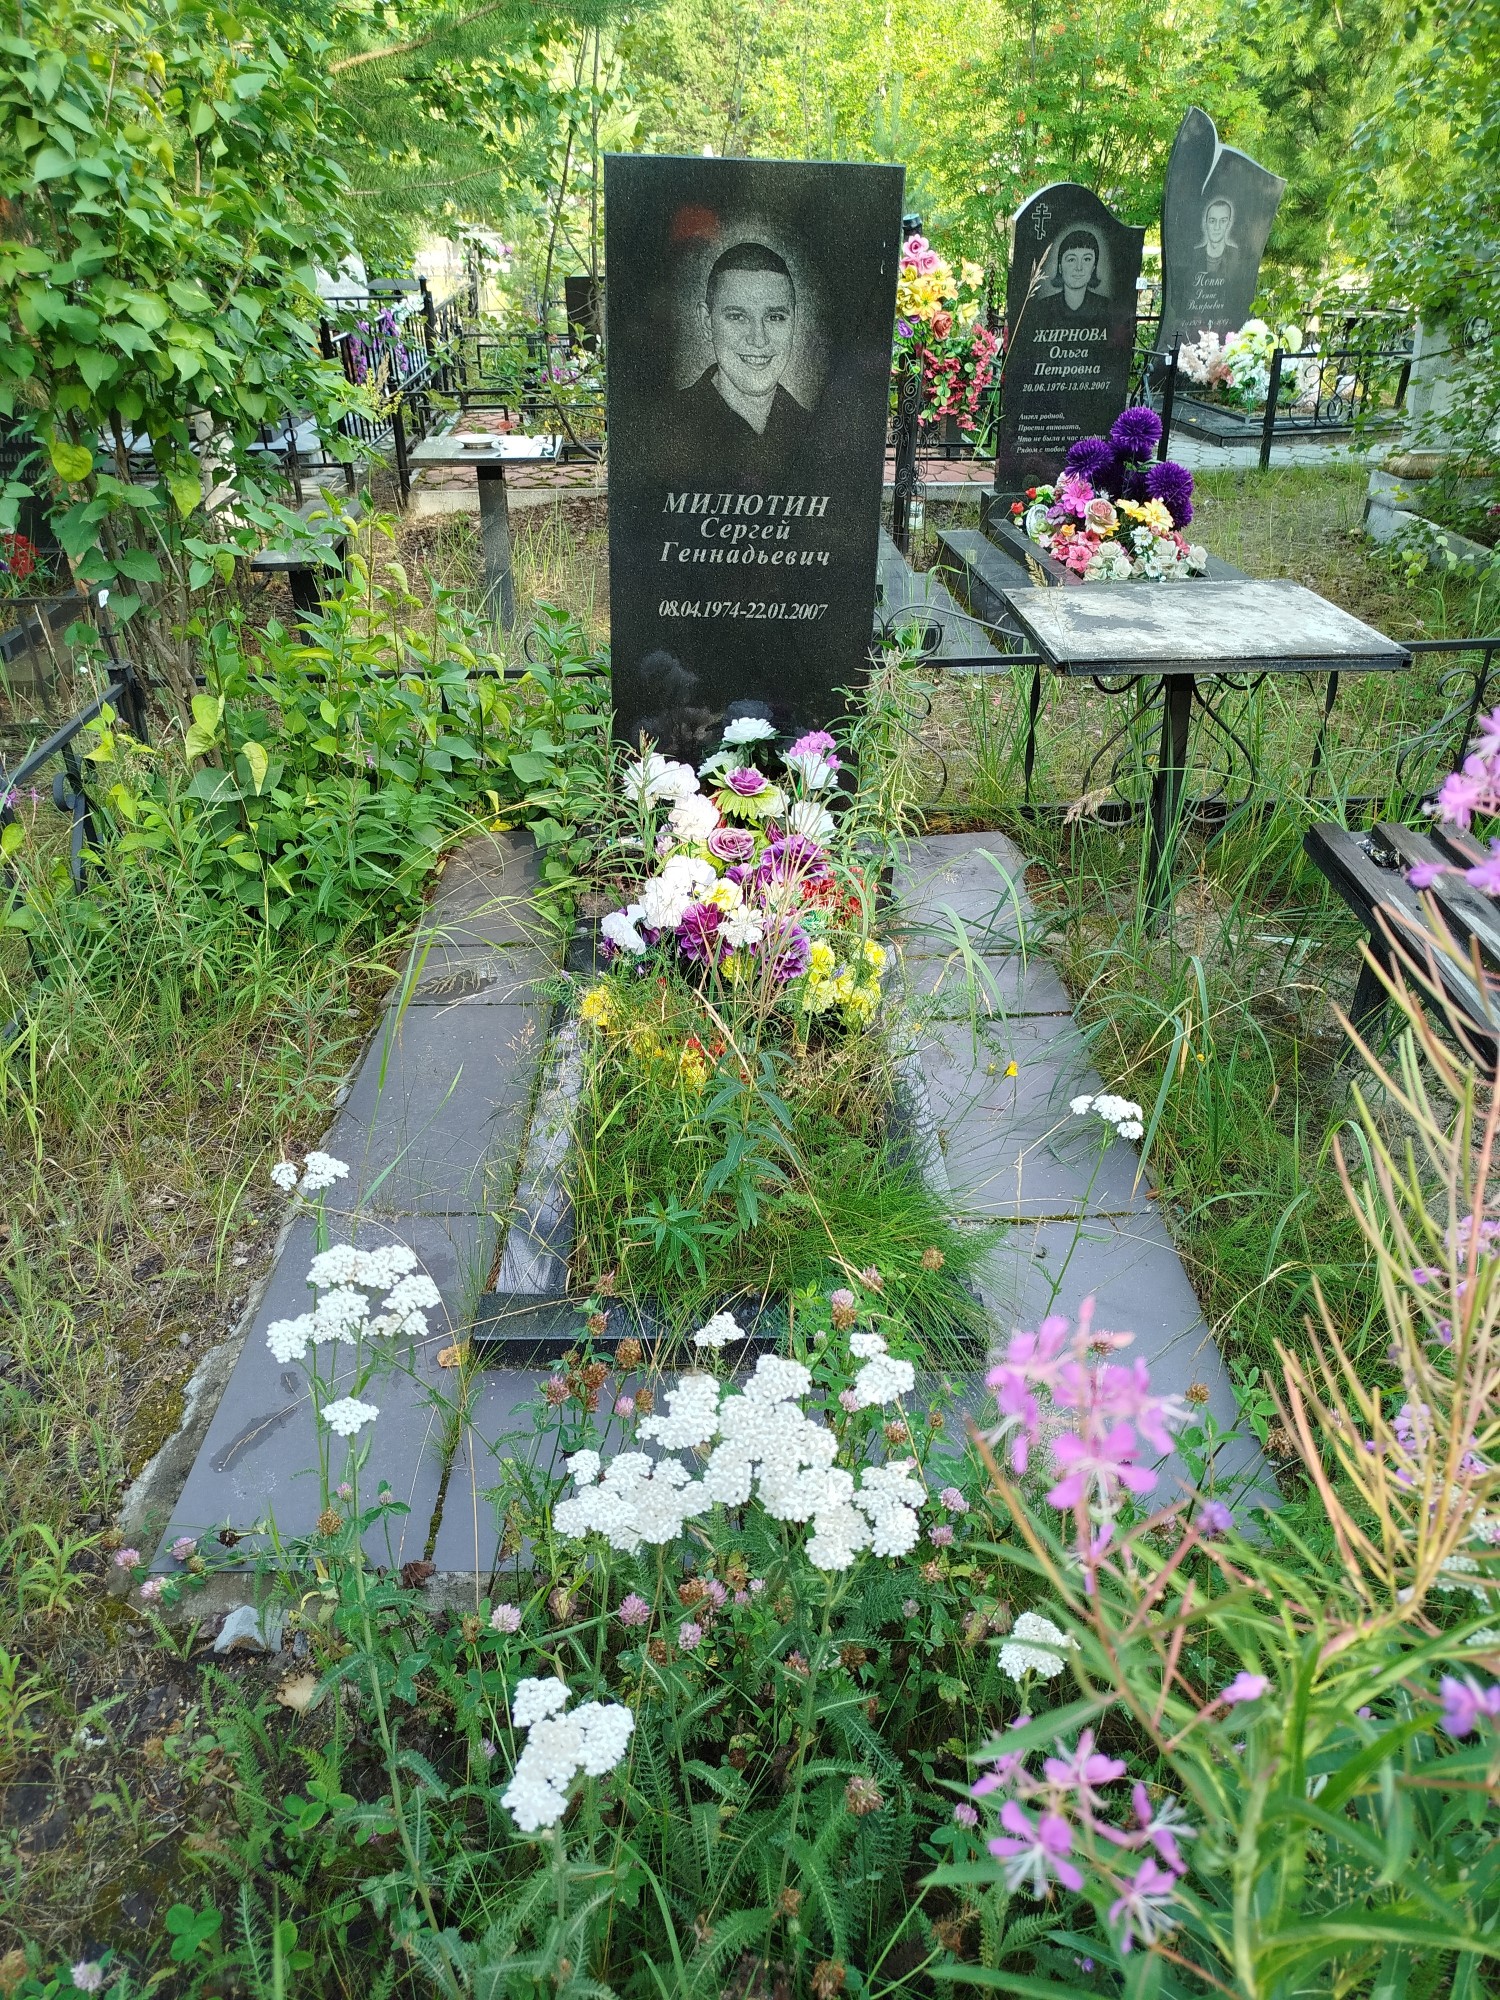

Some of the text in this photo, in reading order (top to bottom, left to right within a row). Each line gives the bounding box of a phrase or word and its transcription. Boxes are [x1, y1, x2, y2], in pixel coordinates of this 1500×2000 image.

[1033, 328, 1108, 343] ЖИРНОВА
[1049, 345, 1089, 359] Ольга
[1033, 362, 1101, 377] Петровна
[1017, 424, 1045, 432] Прости
[1017, 435, 1032, 443] Что
[1042, 434, 1061, 442] была
[1016, 446, 1038, 454] Рядом
[662, 492, 831, 518] МИЛЮТИН
[700, 517, 791, 545] Сергей
[659, 541, 830, 566] Геннадьевич
[658, 600, 829, 620] 08.04.1974-22.01.2007
